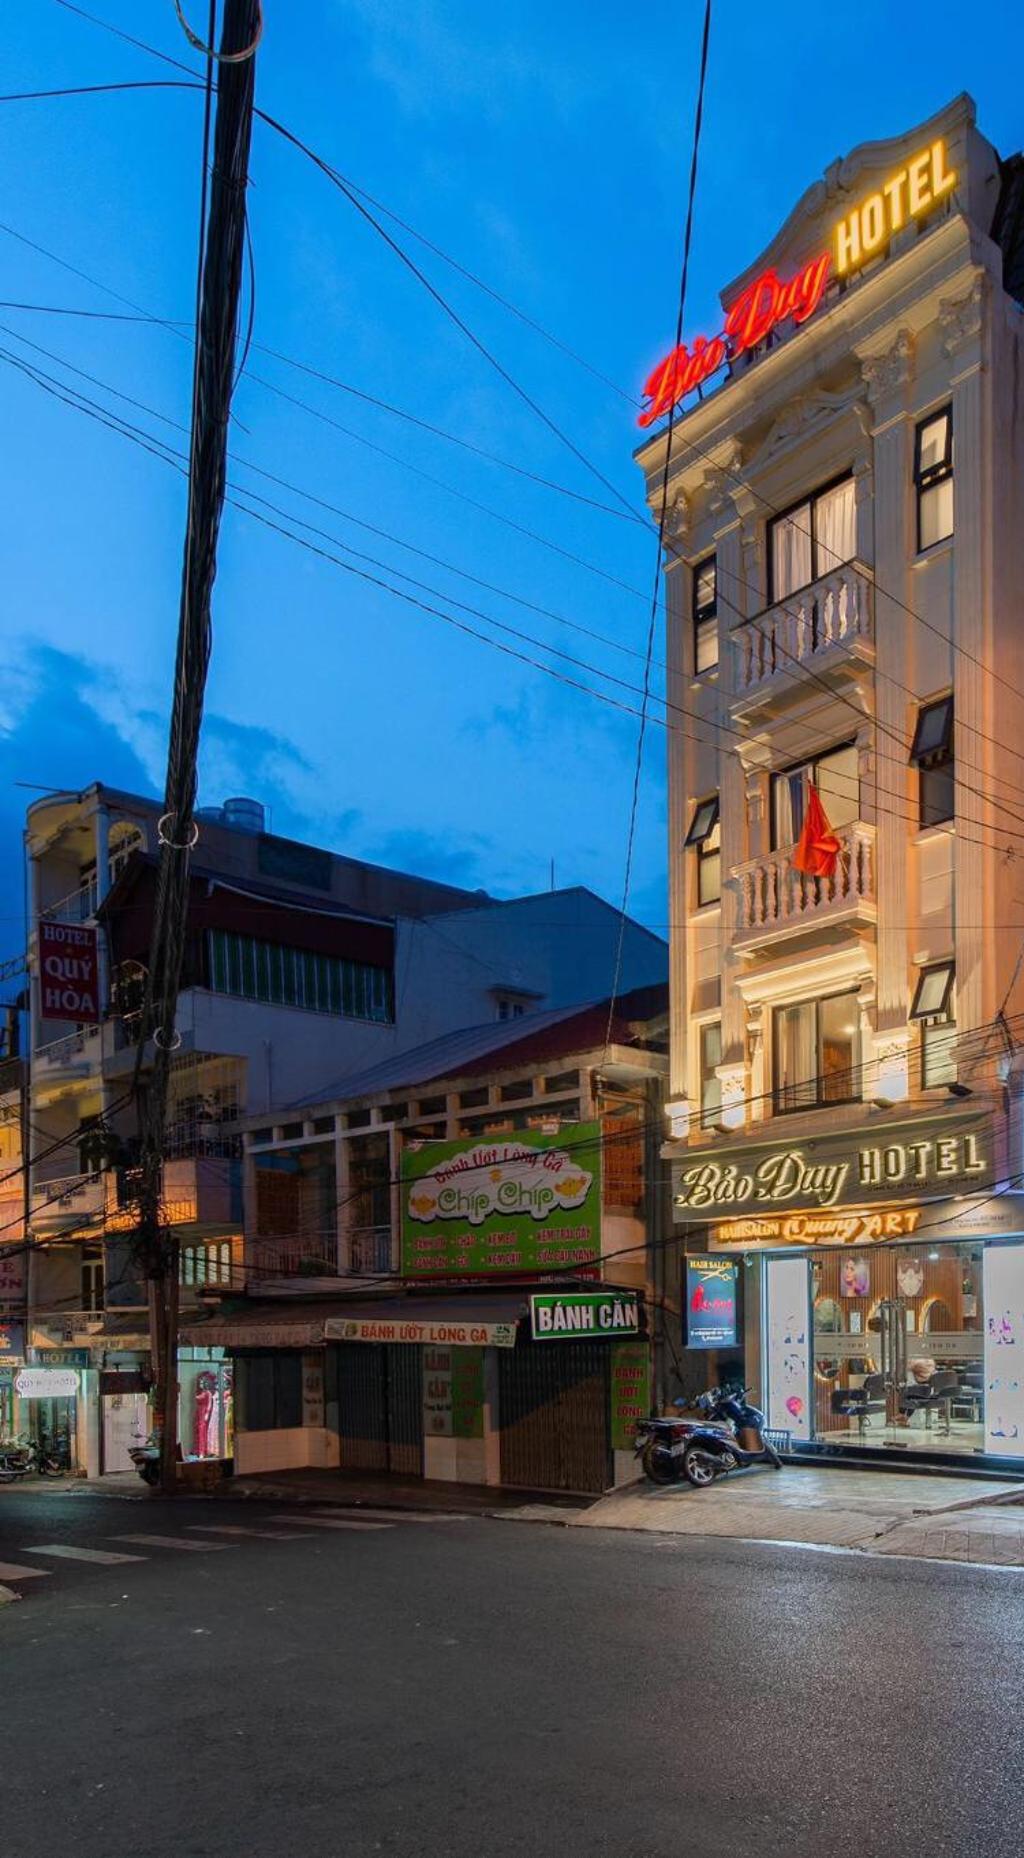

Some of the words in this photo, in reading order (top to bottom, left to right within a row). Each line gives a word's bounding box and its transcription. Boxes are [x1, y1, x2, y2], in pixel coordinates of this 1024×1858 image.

[724, 251, 831, 358] Duy
[836, 138, 957, 275] HOTEL
[44, 925, 93, 946] HOTEL
[45, 955, 92, 981] QUÝ
[45, 984, 96, 1013] HÒA
[674, 1162, 753, 1209] Bảo
[754, 1150, 850, 1207] Duy
[858, 1134, 987, 1185] HOTEL
[539, 1302, 594, 1332] BÁNH
[600, 1299, 638, 1327] CĂN
